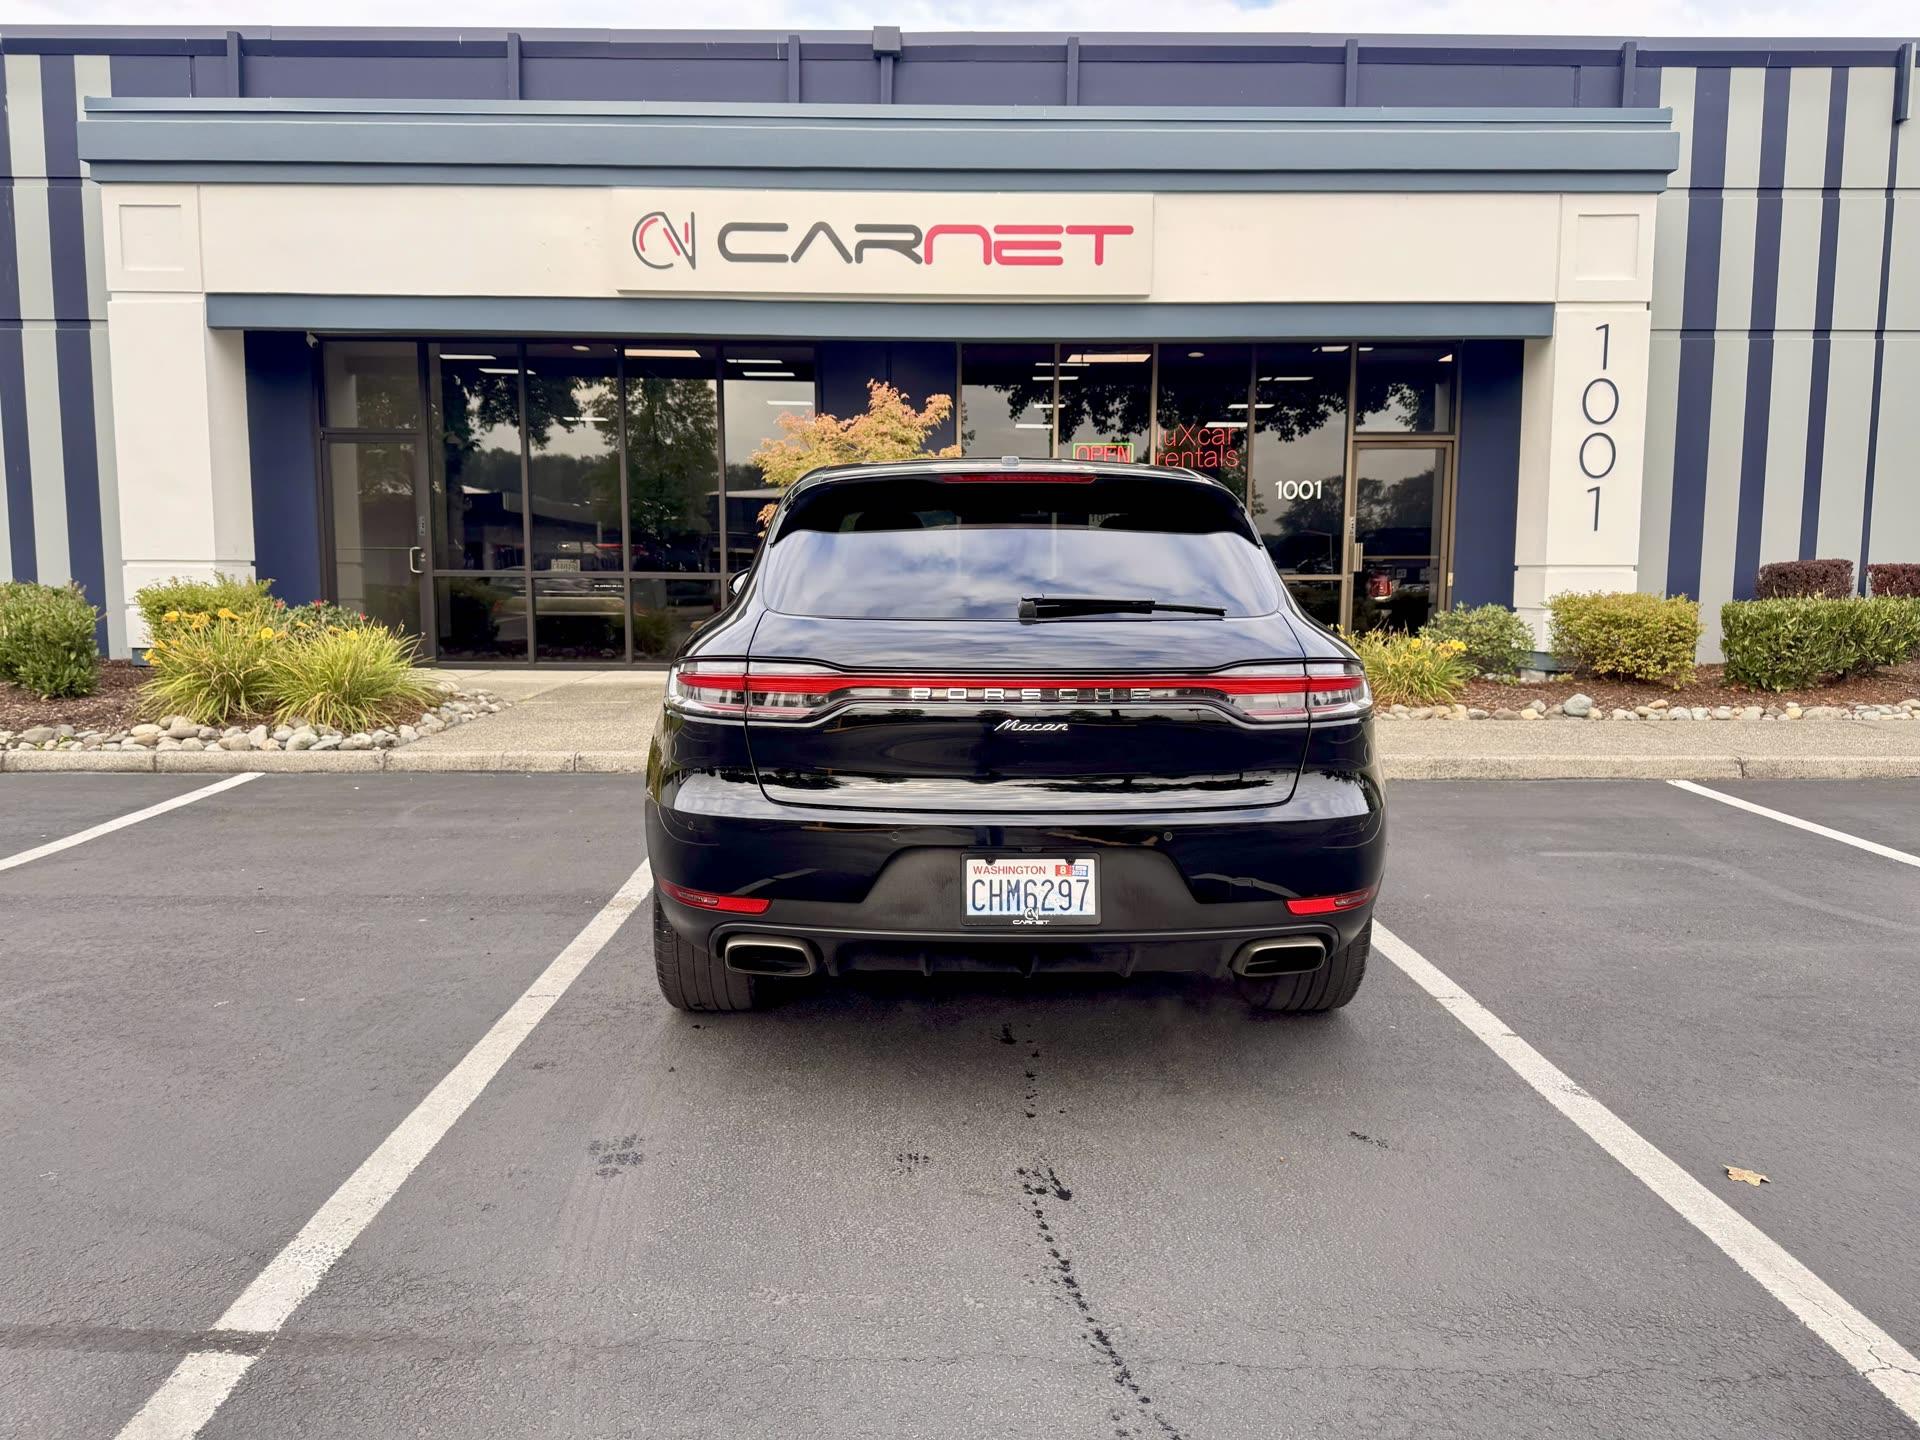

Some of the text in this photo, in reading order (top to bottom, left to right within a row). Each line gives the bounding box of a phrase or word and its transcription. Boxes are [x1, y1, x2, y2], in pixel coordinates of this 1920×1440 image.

[717, 221, 1135, 266] CARNET
[1579, 323, 1619, 532] 1001
[1076, 445, 1130, 463] OPEN
[1155, 445, 1240, 468] rentals
[1275, 480, 1322, 499] 1001
[911, 688, 1151, 703] PORSCHE
[994, 719, 1069, 732] Macan
[972, 865, 1046, 875] WASHINGTON
[972, 879, 1090, 912] CHM6297
